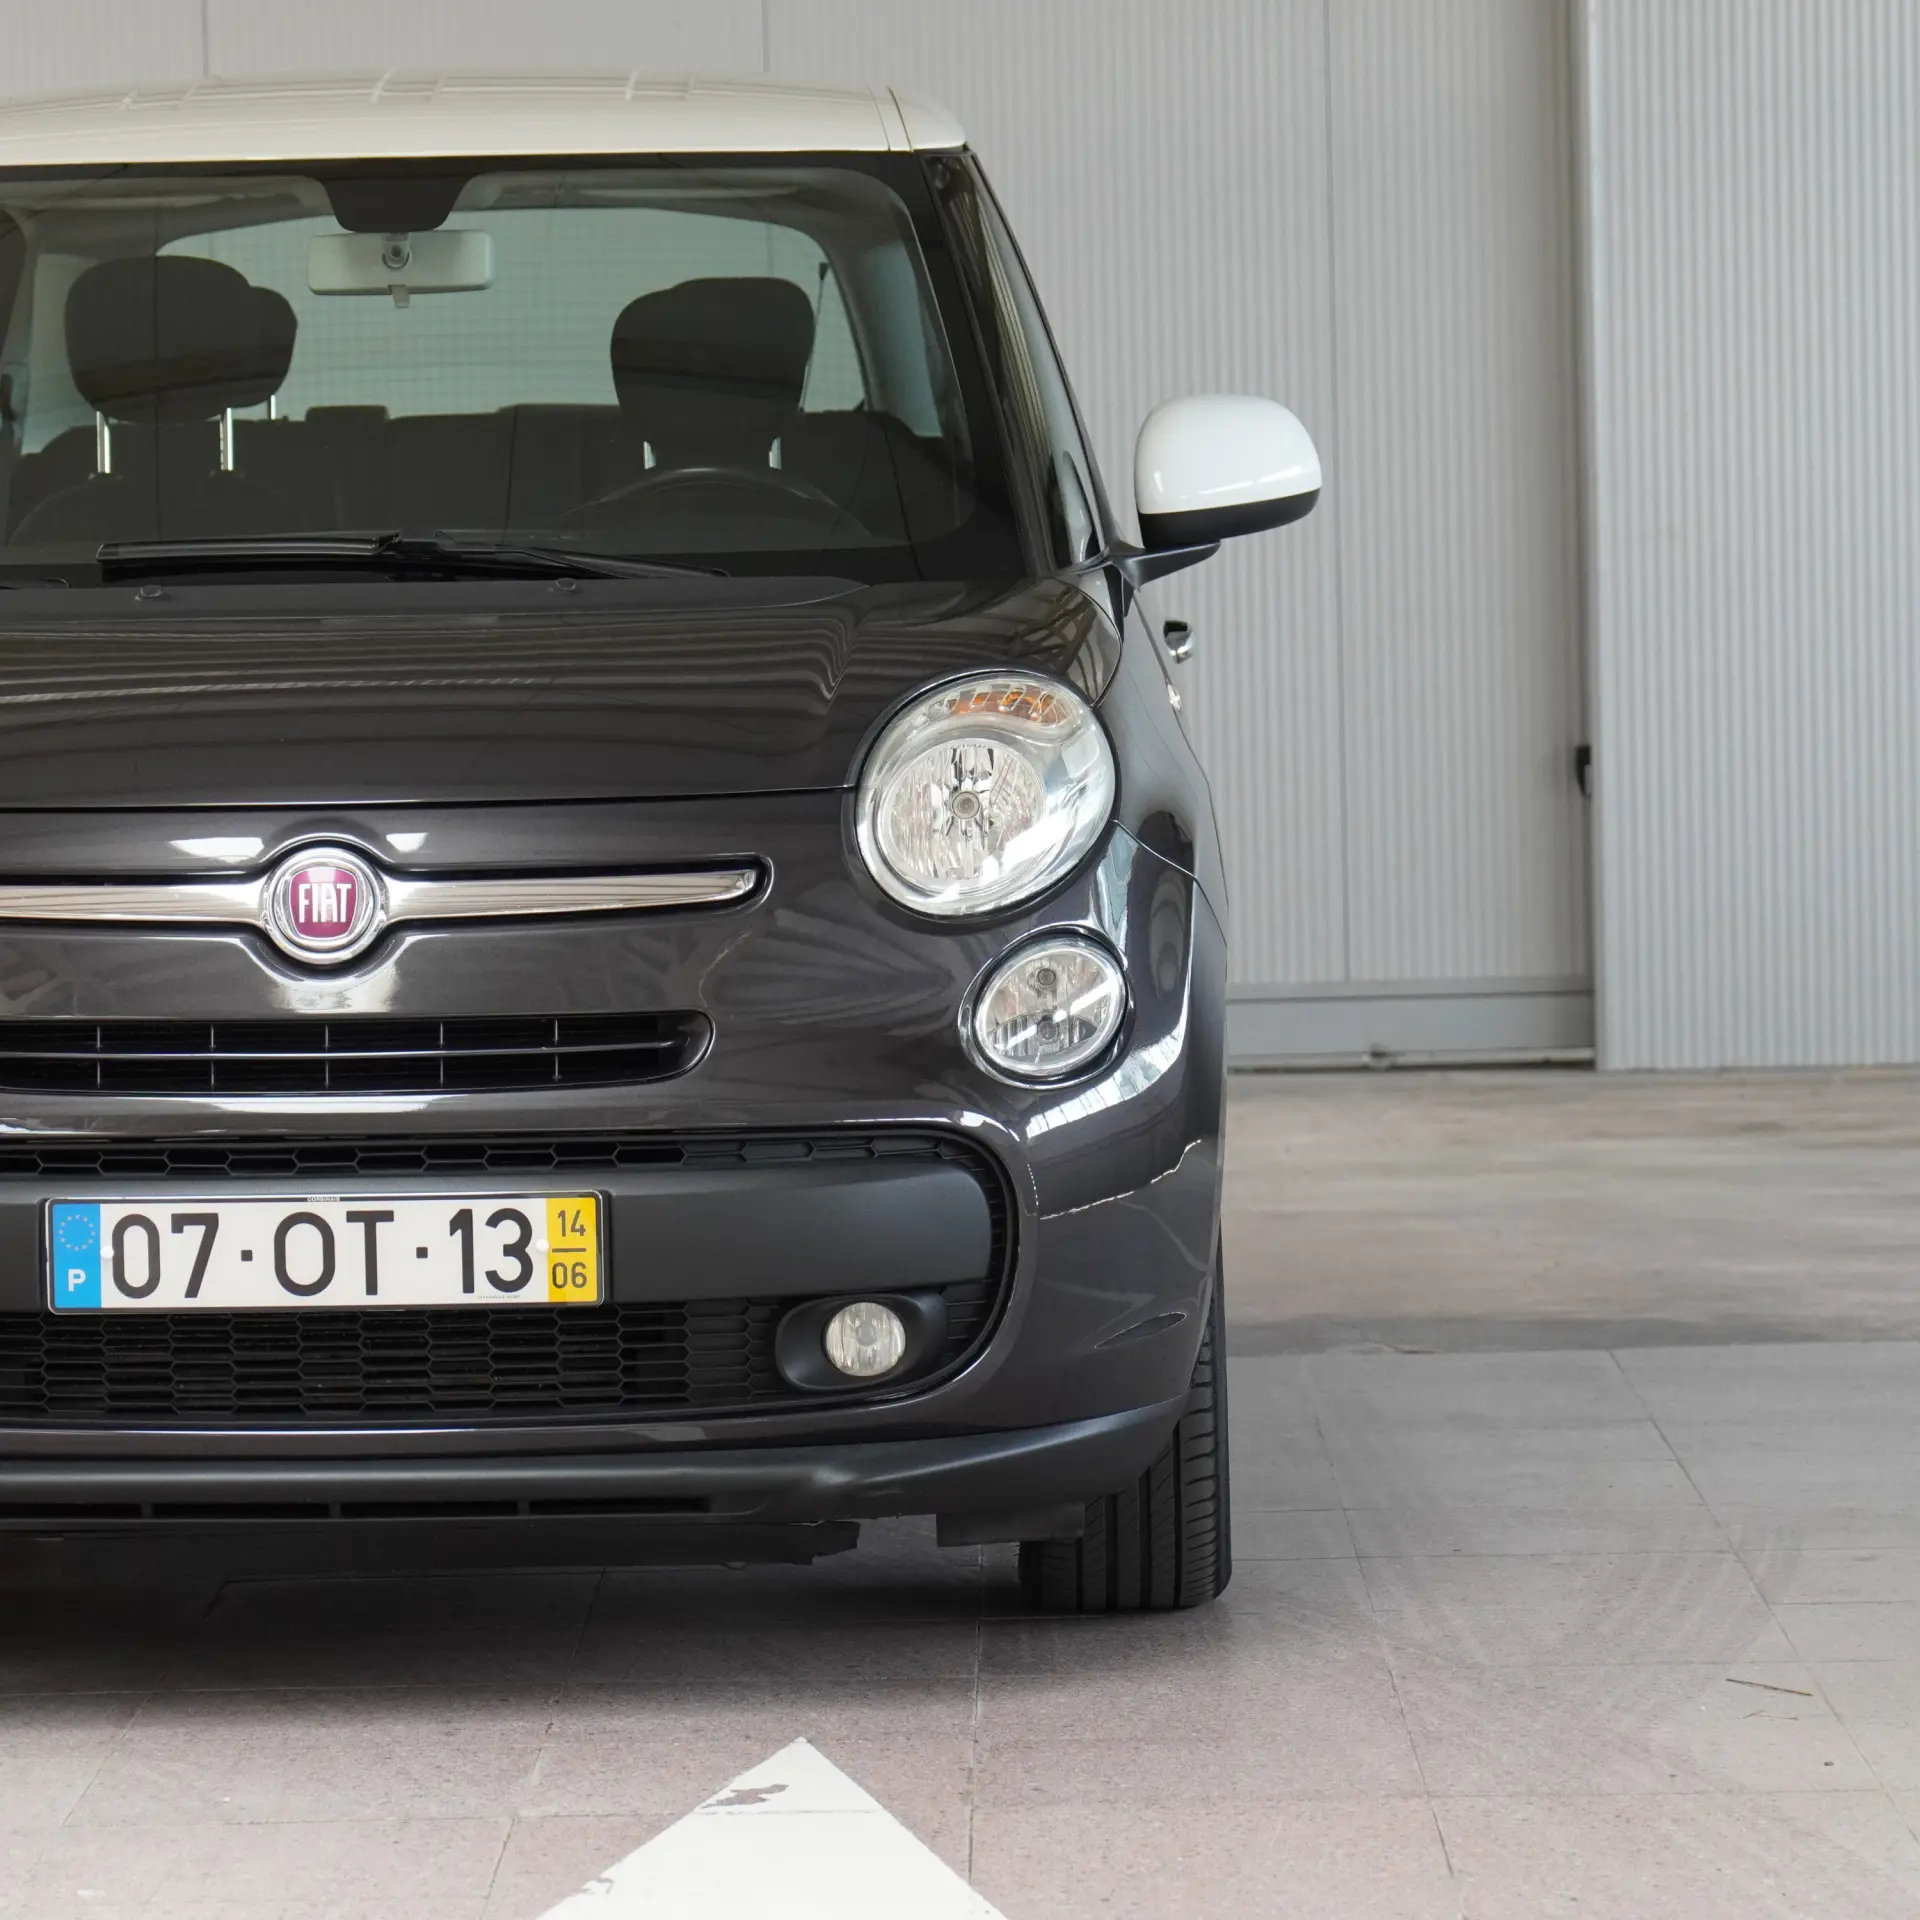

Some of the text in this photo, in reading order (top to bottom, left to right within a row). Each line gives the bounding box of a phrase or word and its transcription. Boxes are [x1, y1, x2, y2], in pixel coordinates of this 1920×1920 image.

[298, 882, 352, 923] FIAT
[557, 1209, 587, 1237] 14
[67, 1268, 87, 1292] P
[551, 1261, 588, 1289] 06
